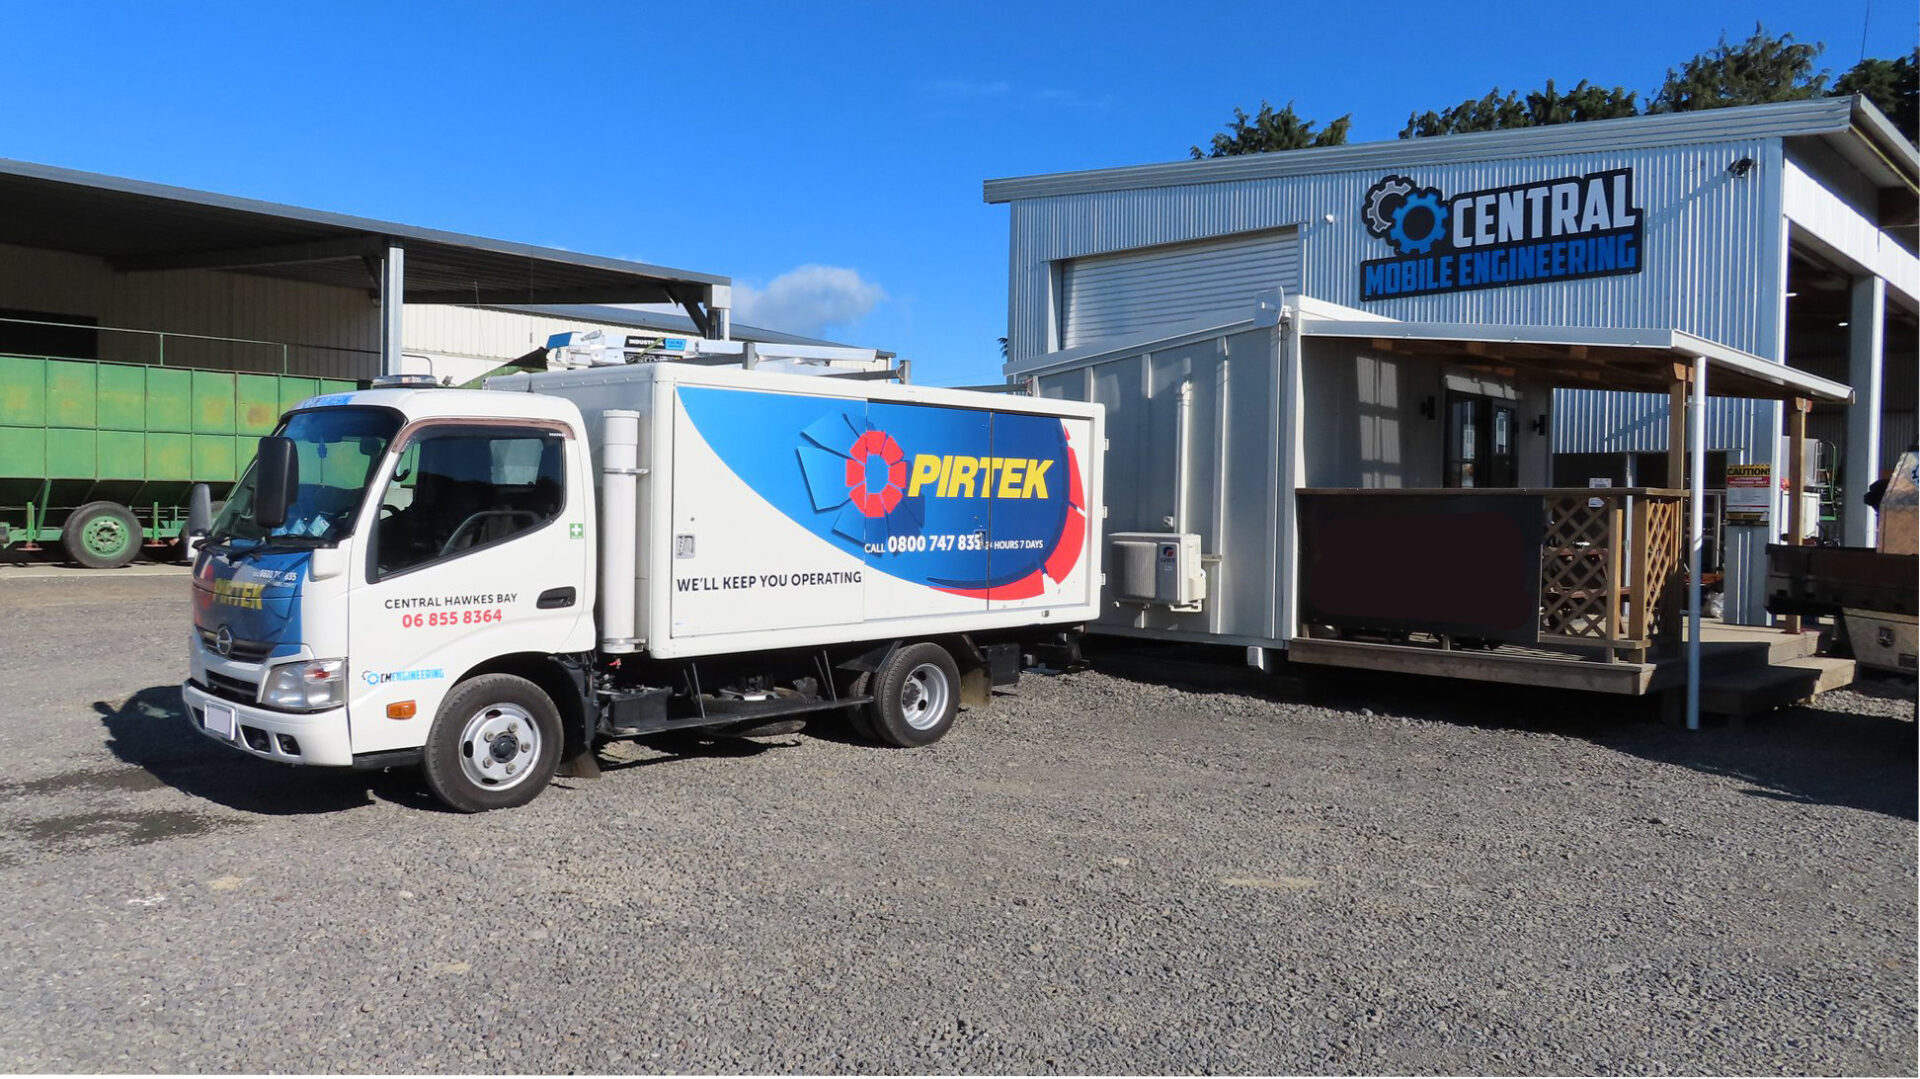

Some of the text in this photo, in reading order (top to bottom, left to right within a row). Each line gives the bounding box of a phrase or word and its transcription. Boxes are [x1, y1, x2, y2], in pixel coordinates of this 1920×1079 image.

[1453, 174, 1636, 248] CENTRAL
[1365, 233, 1636, 296] MOBILE ENGINEERING
[907, 454, 1054, 499] PIRTEK
[865, 543, 886, 553] CALL
[888, 535, 926, 553] 0800
[929, 534, 955, 551] 747
[957, 533, 981, 551] 835
[994, 540, 1018, 550] HOURS
[1020, 540, 1024, 550] 7
[1025, 540, 1043, 549] DAYS
[677, 571, 862, 592] WE'LL KEEP YOU OPERATING
[384, 593, 518, 609] CENTRAL HAWKES BAY
[402, 609, 502, 628] 06 855 8364
